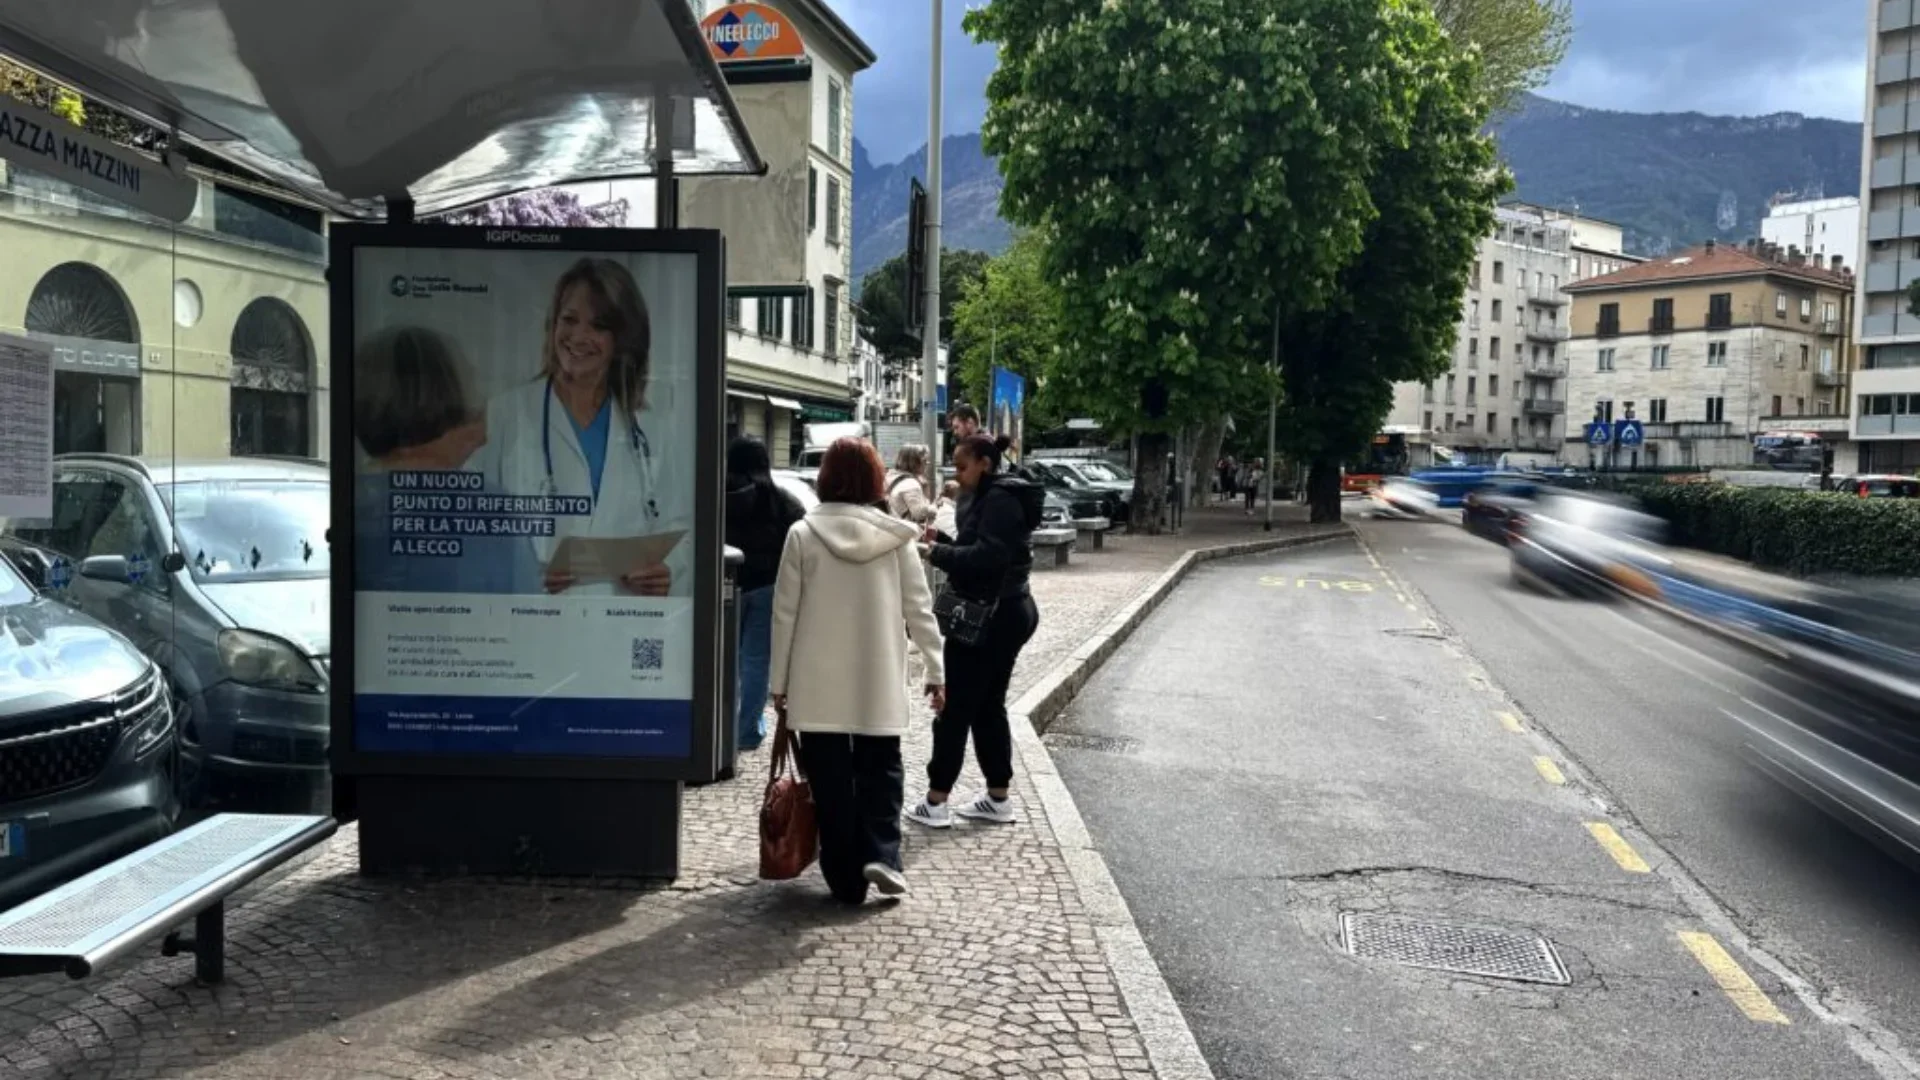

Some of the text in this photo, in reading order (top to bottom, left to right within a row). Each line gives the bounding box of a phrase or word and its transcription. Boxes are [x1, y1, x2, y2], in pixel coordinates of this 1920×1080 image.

[63, 137, 140, 193] MAZZINI
[486, 230, 561, 243] IGPDecaux
[392, 474, 482, 489] UN NUOVO
[392, 495, 589, 513] PUNTO DI RIFERIMENTO
[392, 517, 553, 534] PER LA TUA SALUTE
[392, 539, 461, 555] A LECCO
